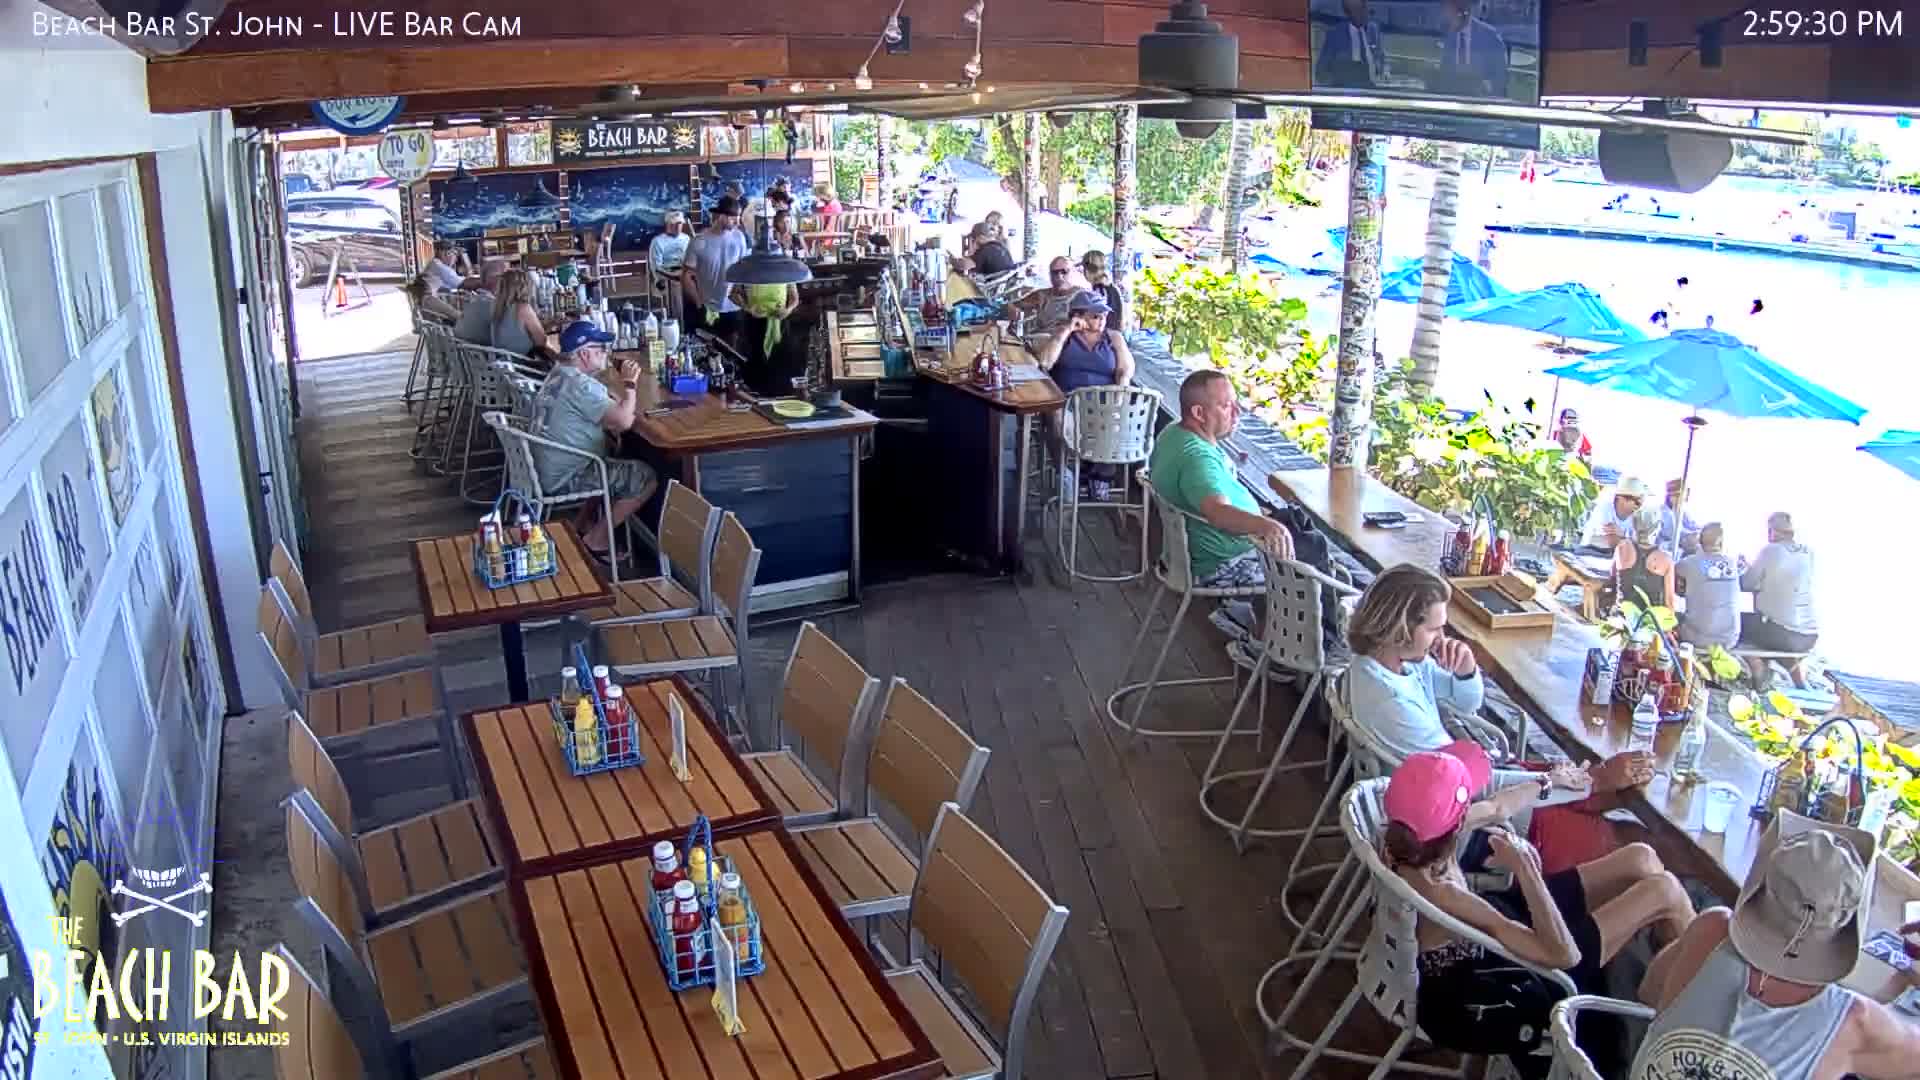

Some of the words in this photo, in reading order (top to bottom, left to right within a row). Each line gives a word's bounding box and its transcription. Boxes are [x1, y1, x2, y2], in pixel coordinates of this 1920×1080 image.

[386, 135, 404, 156] TO
[408, 132, 425, 153] GO
[588, 127, 632, 148] BEACH
[637, 126, 669, 145] BAR
[47, 472, 86, 590] BAR
